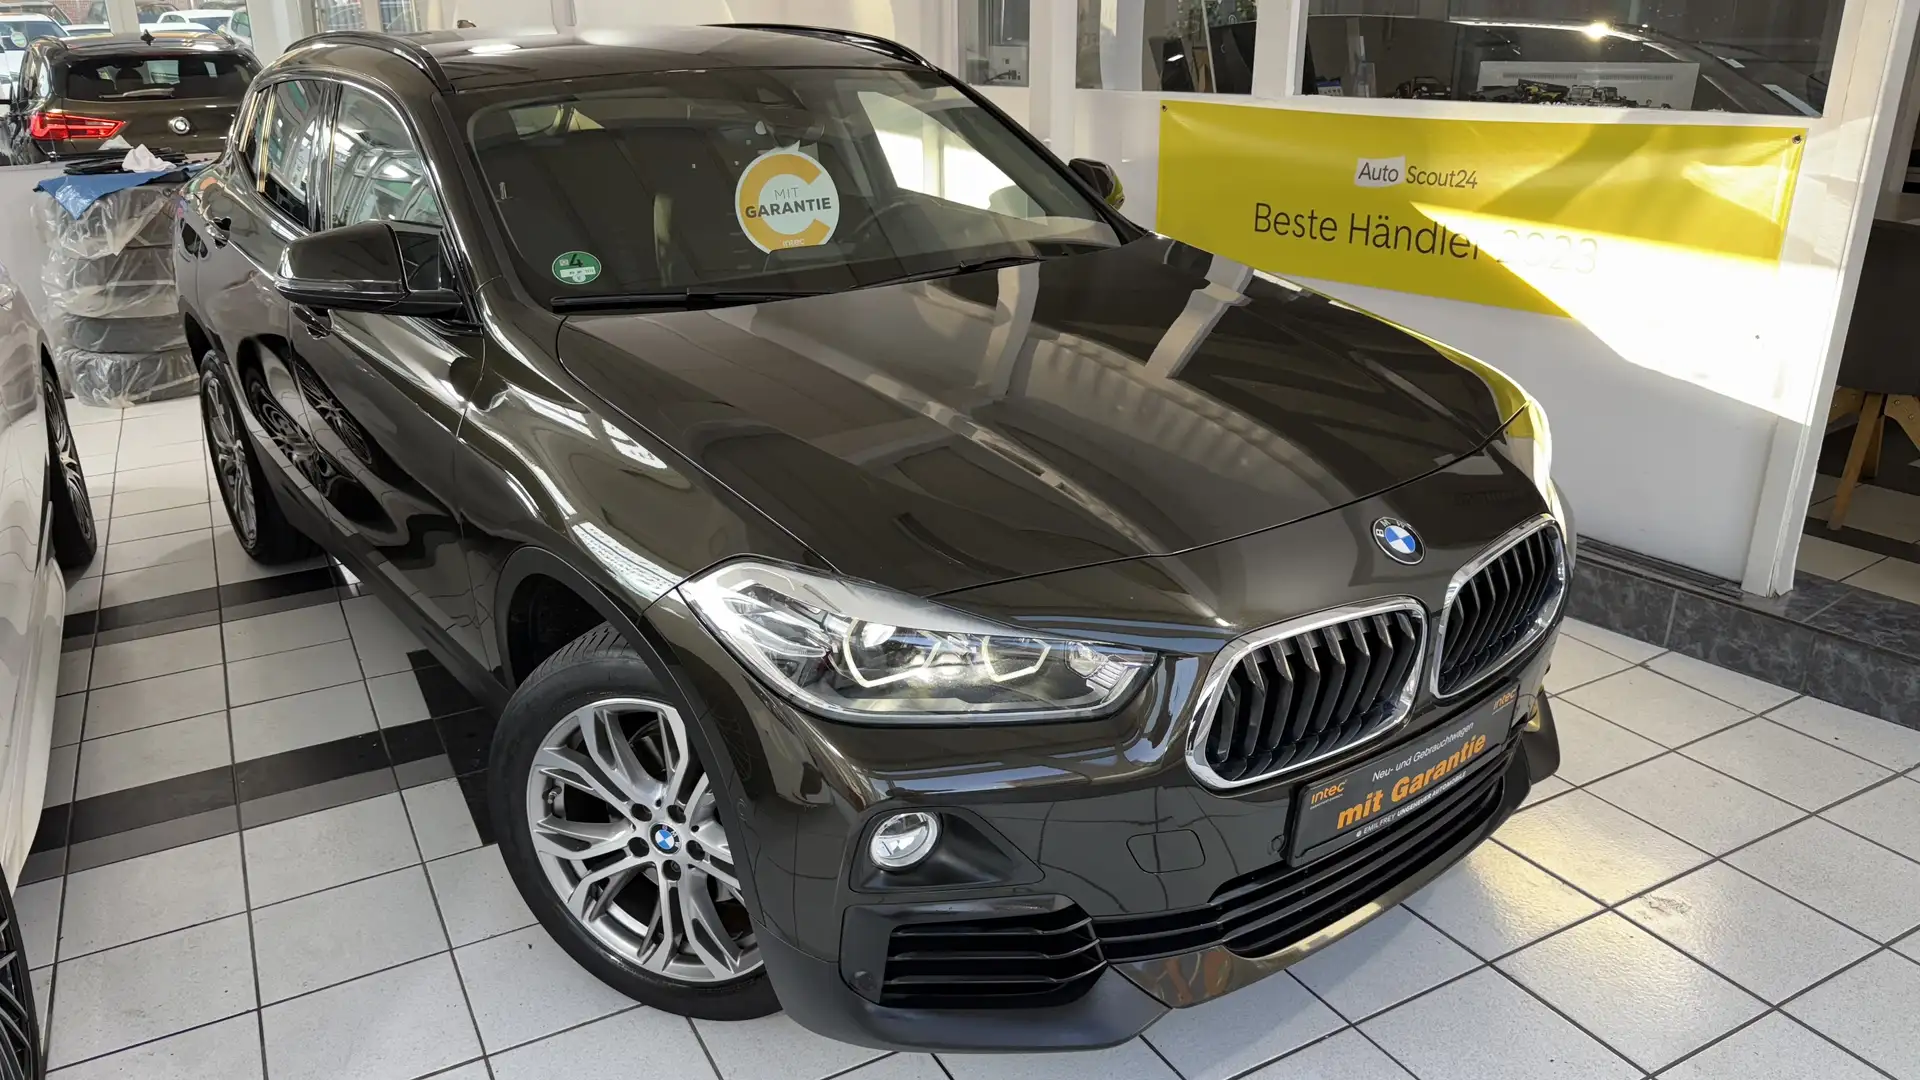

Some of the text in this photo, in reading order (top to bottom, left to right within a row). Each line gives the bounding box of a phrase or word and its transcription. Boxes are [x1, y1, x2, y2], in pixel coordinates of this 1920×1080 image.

[1357, 161, 1478, 191] Auto Scout24
[773, 187, 799, 201] MIT
[745, 197, 831, 218] GARANTIE
[1253, 201, 1338, 243] Beste
[569, 253, 584, 268] 4
[1372, 721, 1474, 782] Neu- und Gebrauchtwagen
[1336, 732, 1487, 830] mit Garantie
[1379, 813, 1398, 830] FREY
